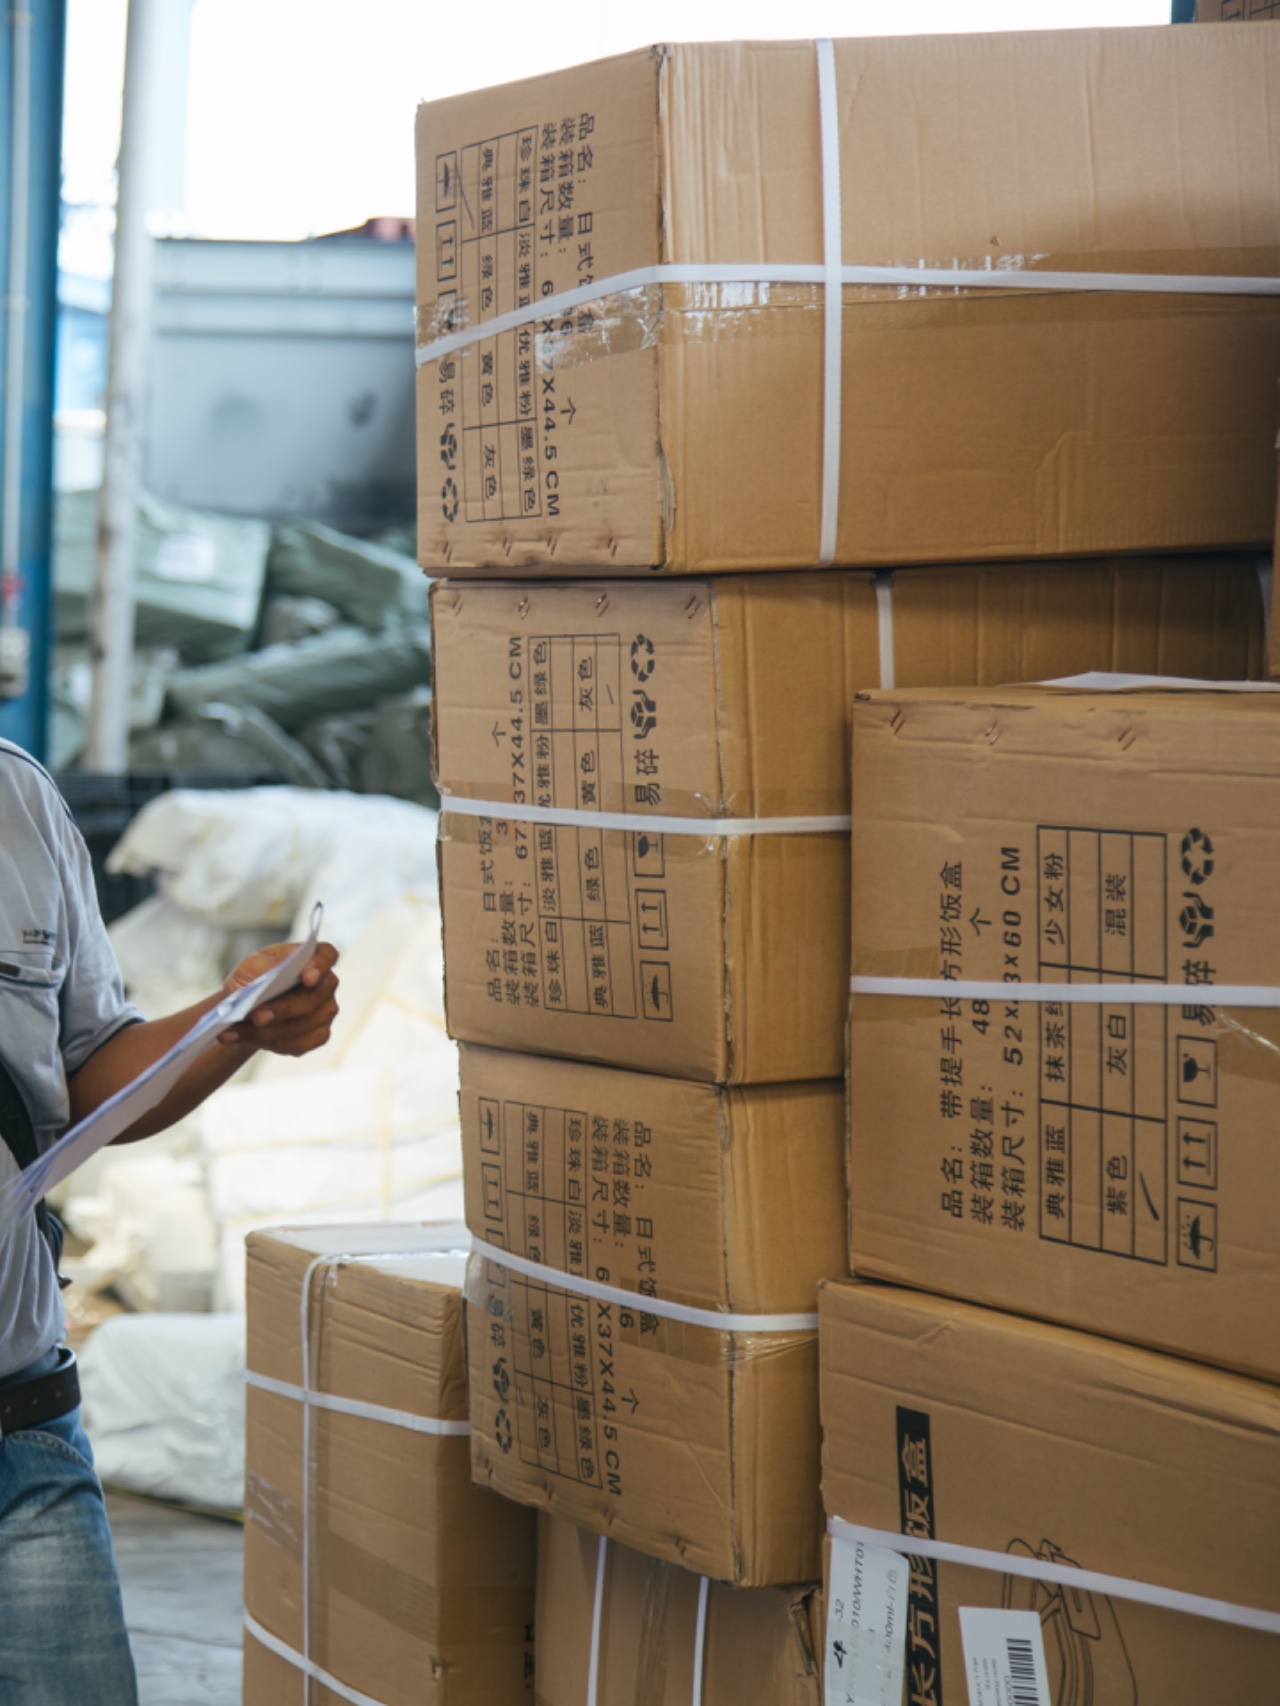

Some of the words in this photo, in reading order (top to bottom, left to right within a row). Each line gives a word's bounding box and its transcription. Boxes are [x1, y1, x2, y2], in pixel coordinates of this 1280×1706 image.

[482, 148, 493, 233] 典雅蓝
[519, 135, 532, 223] 珍珠白
[482, 255, 493, 311] 绿色
[439, 361, 455, 415] 易碎
[482, 351, 493, 407] 黄色
[519, 329, 531, 415] 优雅粉
[561, 397, 576, 425] 个
[485, 444, 496, 499] 灰色
[521, 426, 535, 512] 墨绿色
[546, 470, 559, 516] CM
[509, 637, 522, 679] CM
[533, 642, 548, 725] 墨绿色
[578, 656, 593, 712] 灰色
[492, 721, 506, 747] 个
[510, 689, 528, 859] 6737X44.5
[581, 750, 596, 805] 黄色
[634, 748, 660, 806] 易碎
[539, 828, 556, 911] 淡雅蓝
[585, 847, 601, 901] 绿色
[1000, 847, 1020, 896] CM
[1044, 852, 1064, 945] 少女粉
[969, 908, 992, 936] 个
[1105, 873, 1127, 936] 混装
[545, 922, 562, 1003] 珍珠白
[589, 925, 608, 1008] 典雅蓝
[972, 999, 990, 1034] 48
[1106, 1014, 1128, 1076] 灰白
[527, 1112, 539, 1193] 典雅蓝
[569, 1118, 581, 1201] 珍珠白
[1045, 1125, 1066, 1219] 典雅蓝
[1106, 1155, 1128, 1215] 紫色
[531, 1308, 545, 1360] 黄色
[570, 1304, 587, 1387] 优雅粉
[595, 1268, 617, 1439] 6X37X44.5
[537, 1397, 551, 1449] 灰色
[621, 1388, 639, 1414] 个
[577, 1397, 595, 1479] 墨绿色
[605, 1450, 621, 1495] CM
